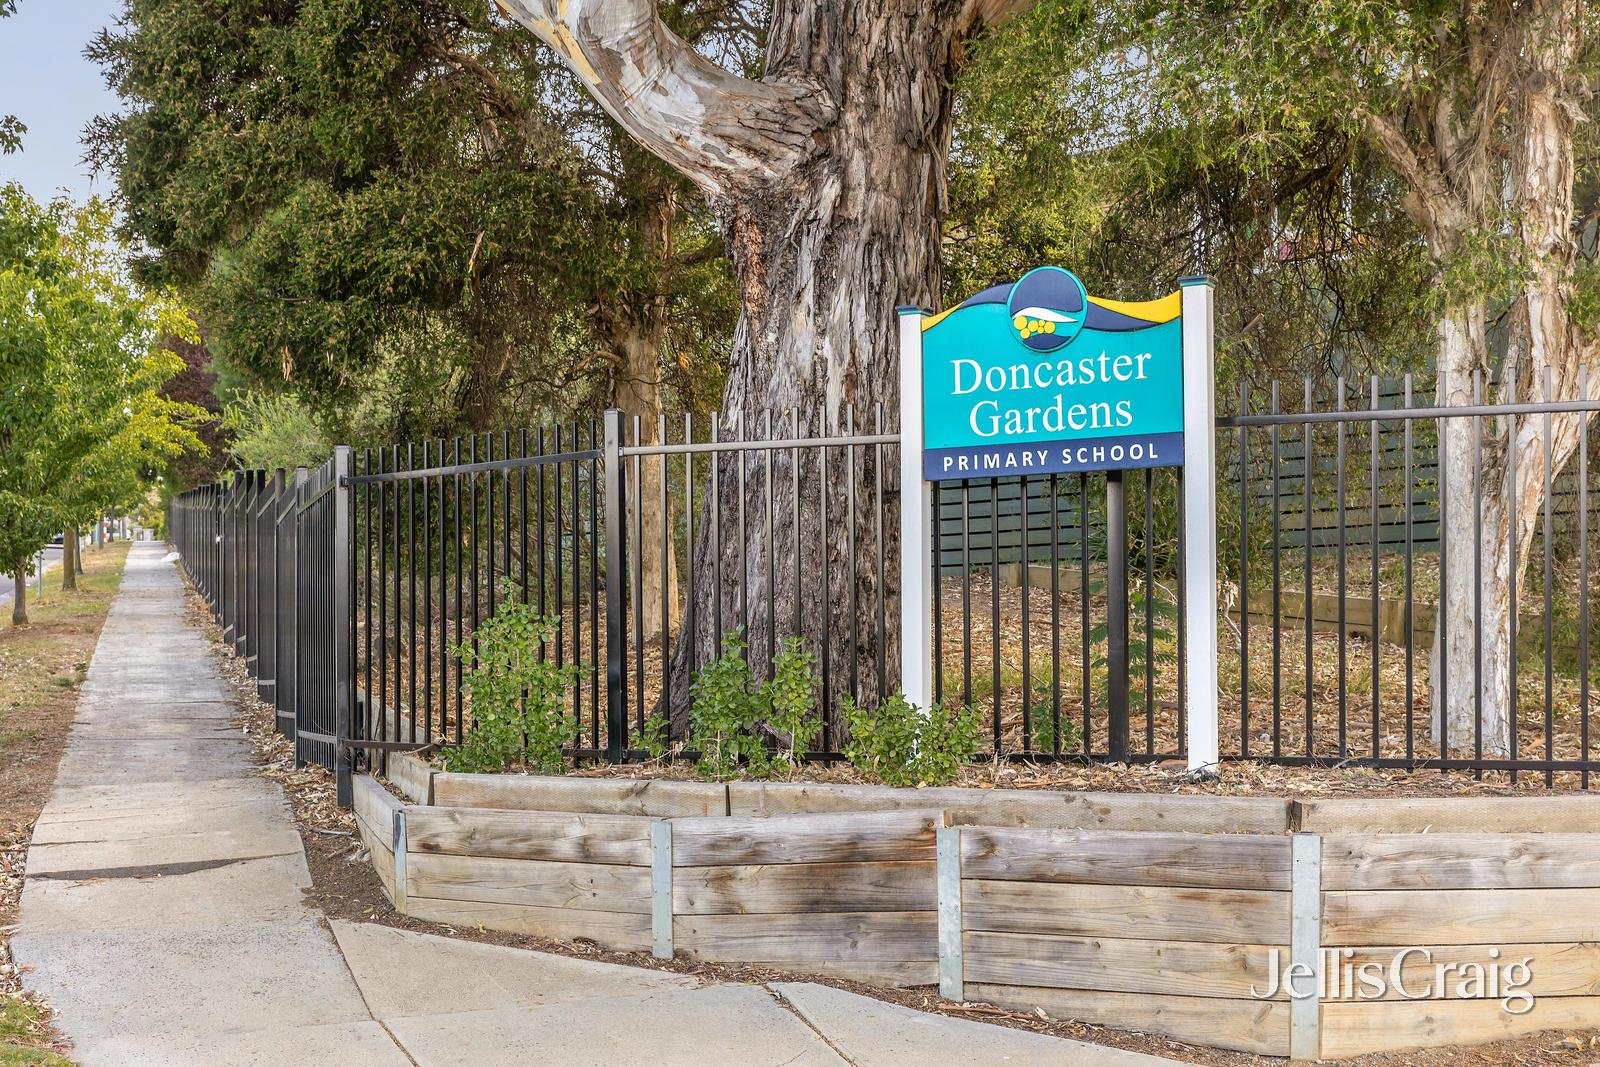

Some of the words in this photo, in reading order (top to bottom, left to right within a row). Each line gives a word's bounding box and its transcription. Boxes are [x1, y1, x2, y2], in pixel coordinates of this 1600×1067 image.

[950, 349, 1152, 395] Doncaster
[969, 394, 1133, 437] Gardens
[943, 450, 1048, 472] PRIMARY
[1062, 443, 1159, 464] SCHOOL
